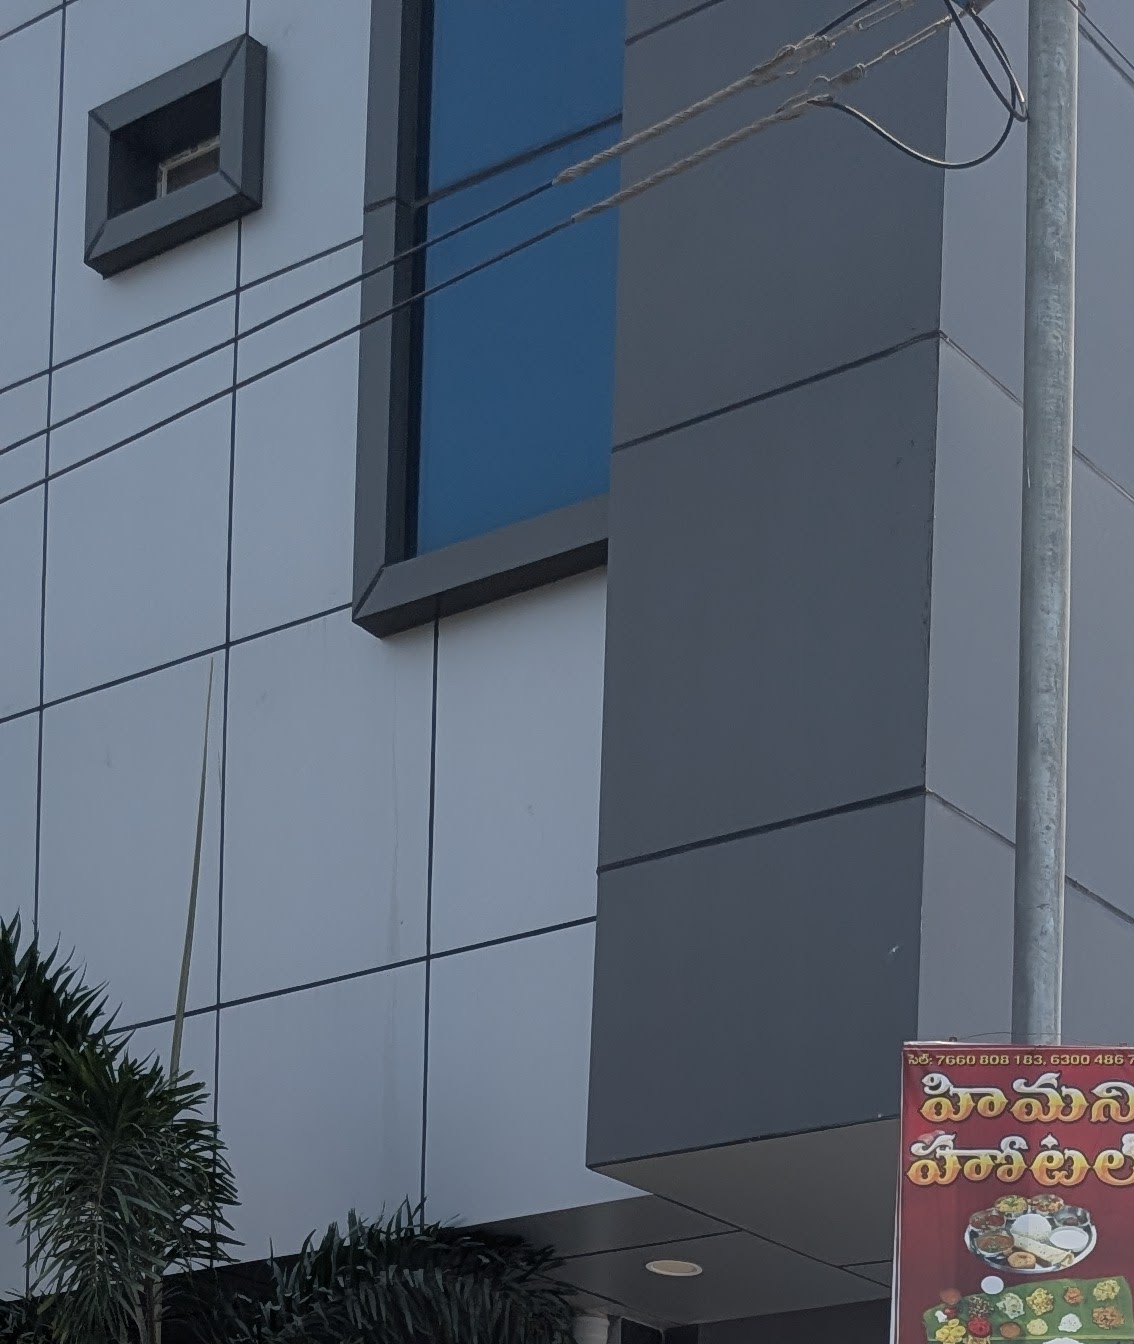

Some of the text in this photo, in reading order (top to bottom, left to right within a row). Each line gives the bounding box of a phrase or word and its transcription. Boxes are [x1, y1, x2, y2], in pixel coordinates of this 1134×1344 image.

[936, 1055, 976, 1066] 7660
[979, 1055, 1009, 1066] 808
[1050, 1055, 1090, 1066] 6300
[1094, 1055, 1124, 1066] 486
